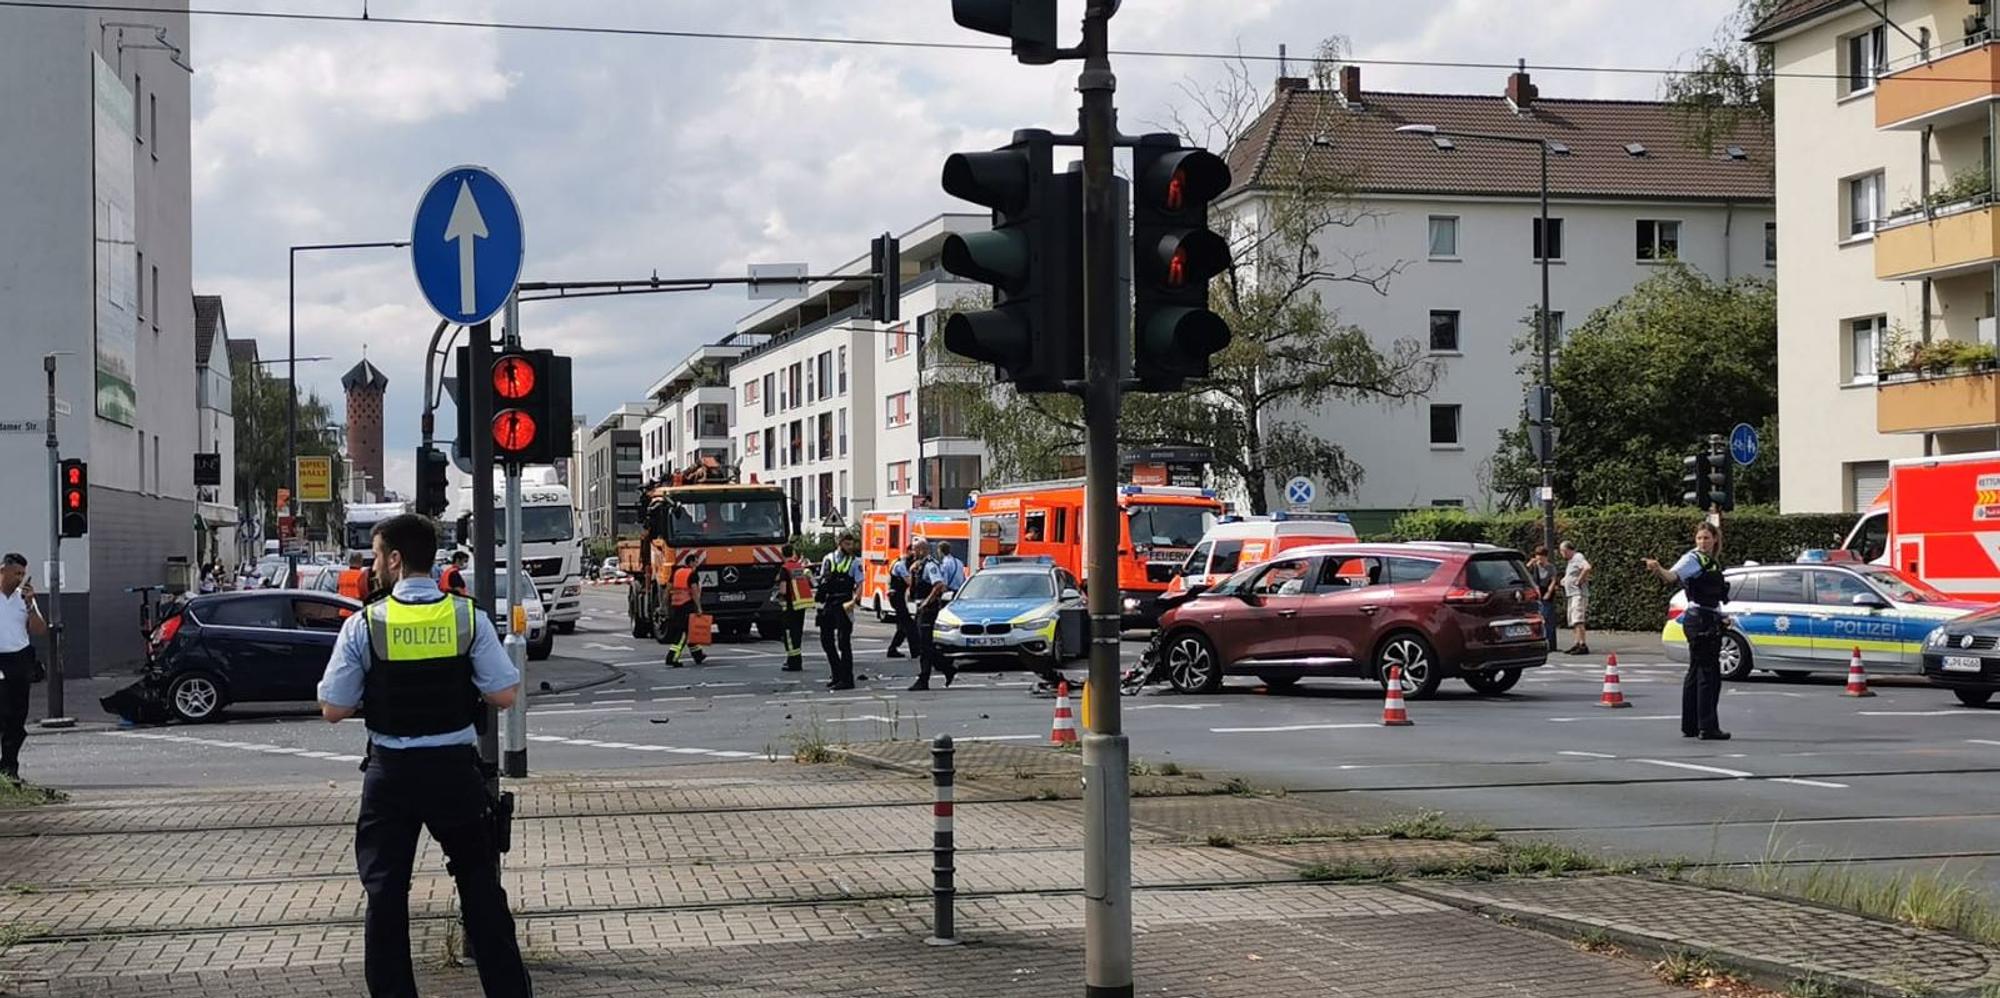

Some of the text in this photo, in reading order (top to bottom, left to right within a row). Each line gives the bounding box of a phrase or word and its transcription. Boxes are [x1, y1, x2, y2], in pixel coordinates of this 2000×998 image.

[701, 573, 713, 584] A
[392, 626, 452, 645] POLIZEI
[1833, 620, 1897, 637] POLIZEI
